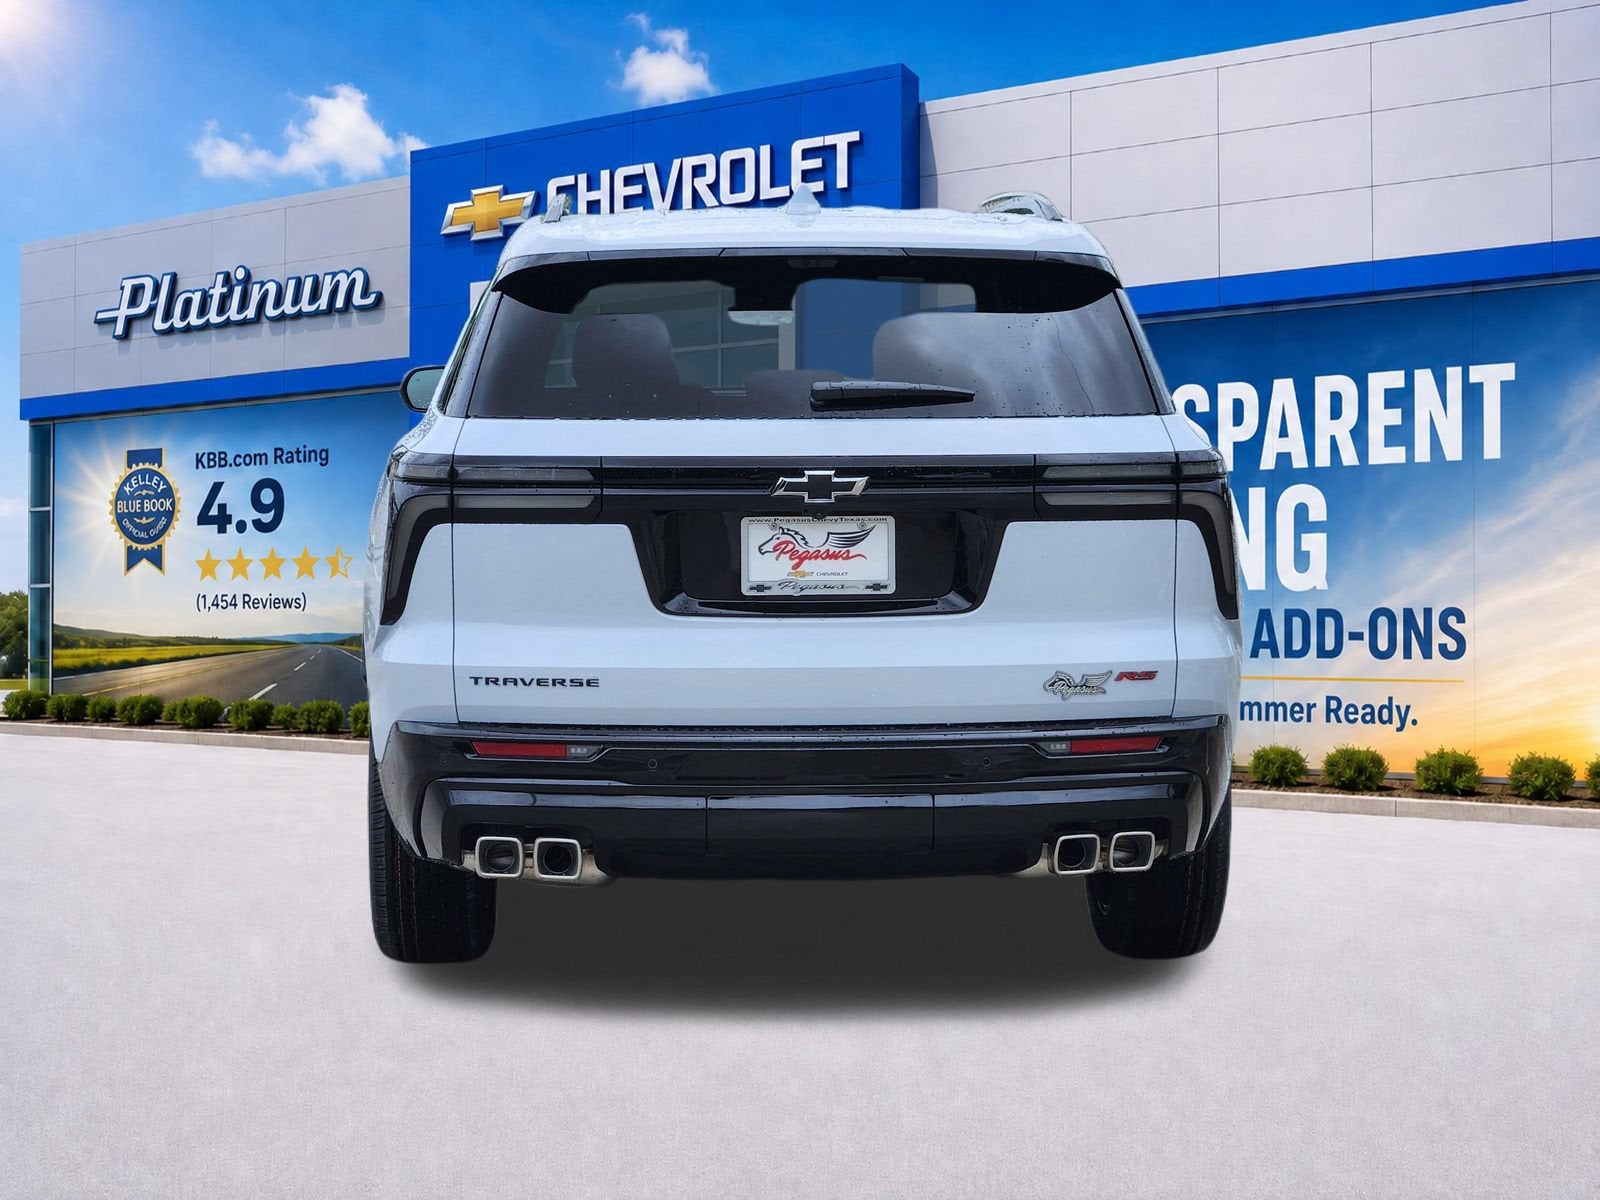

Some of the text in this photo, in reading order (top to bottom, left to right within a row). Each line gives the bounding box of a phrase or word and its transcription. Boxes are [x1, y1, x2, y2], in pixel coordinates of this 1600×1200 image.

[546, 130, 861, 214] CHEVROLET
[94, 265, 384, 339] Platinum
[195, 444, 330, 470] KBB.com Rating
[123, 473, 167, 496] KELLEY
[117, 498, 173, 513] BLUE BOOK
[196, 477, 285, 534] 4.9
[772, 539, 868, 571] Pegasus
[196, 592, 307, 612] (1,454 Reviews)
[1249, 606, 1467, 661] ADD-ONS
[469, 676, 600, 688] TRAVERSE
[1114, 670, 1159, 682] RS
[1325, 695, 1418, 732] Ready.
